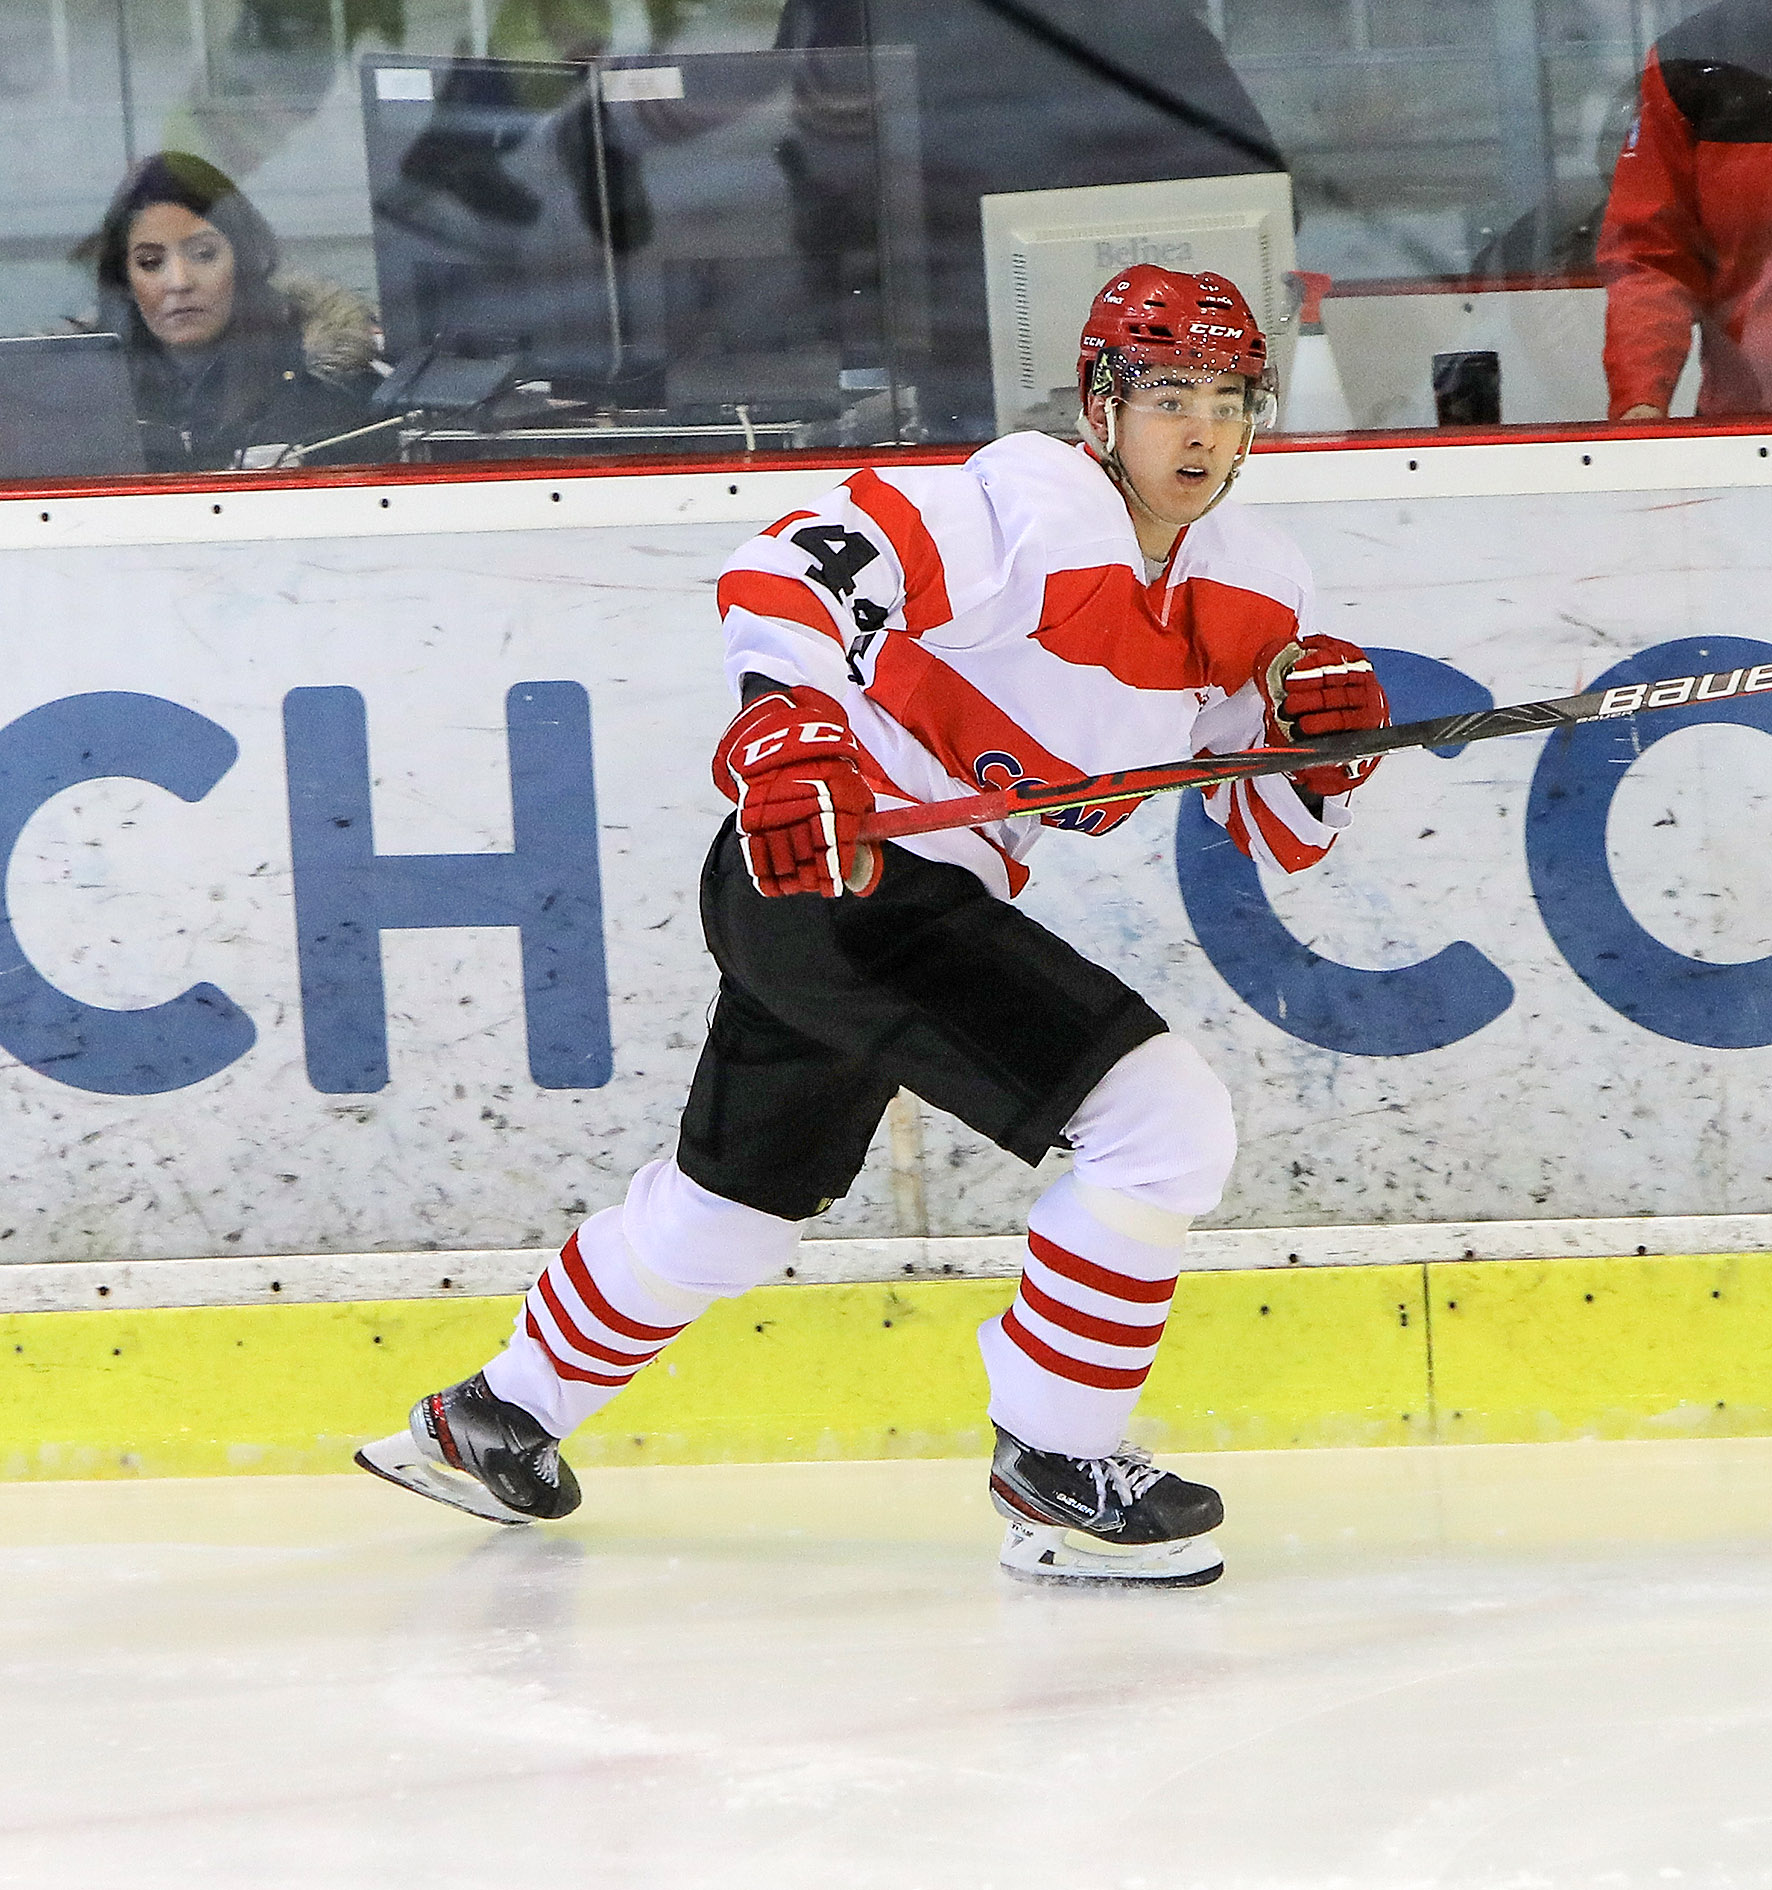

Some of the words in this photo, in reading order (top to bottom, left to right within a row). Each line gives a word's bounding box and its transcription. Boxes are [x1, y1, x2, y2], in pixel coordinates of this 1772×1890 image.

[1083, 335, 1106, 348] CCM
[1189, 323, 1244, 339] CCM
[743, 721, 860, 767] CC
[0, 680, 614, 1095] CH
